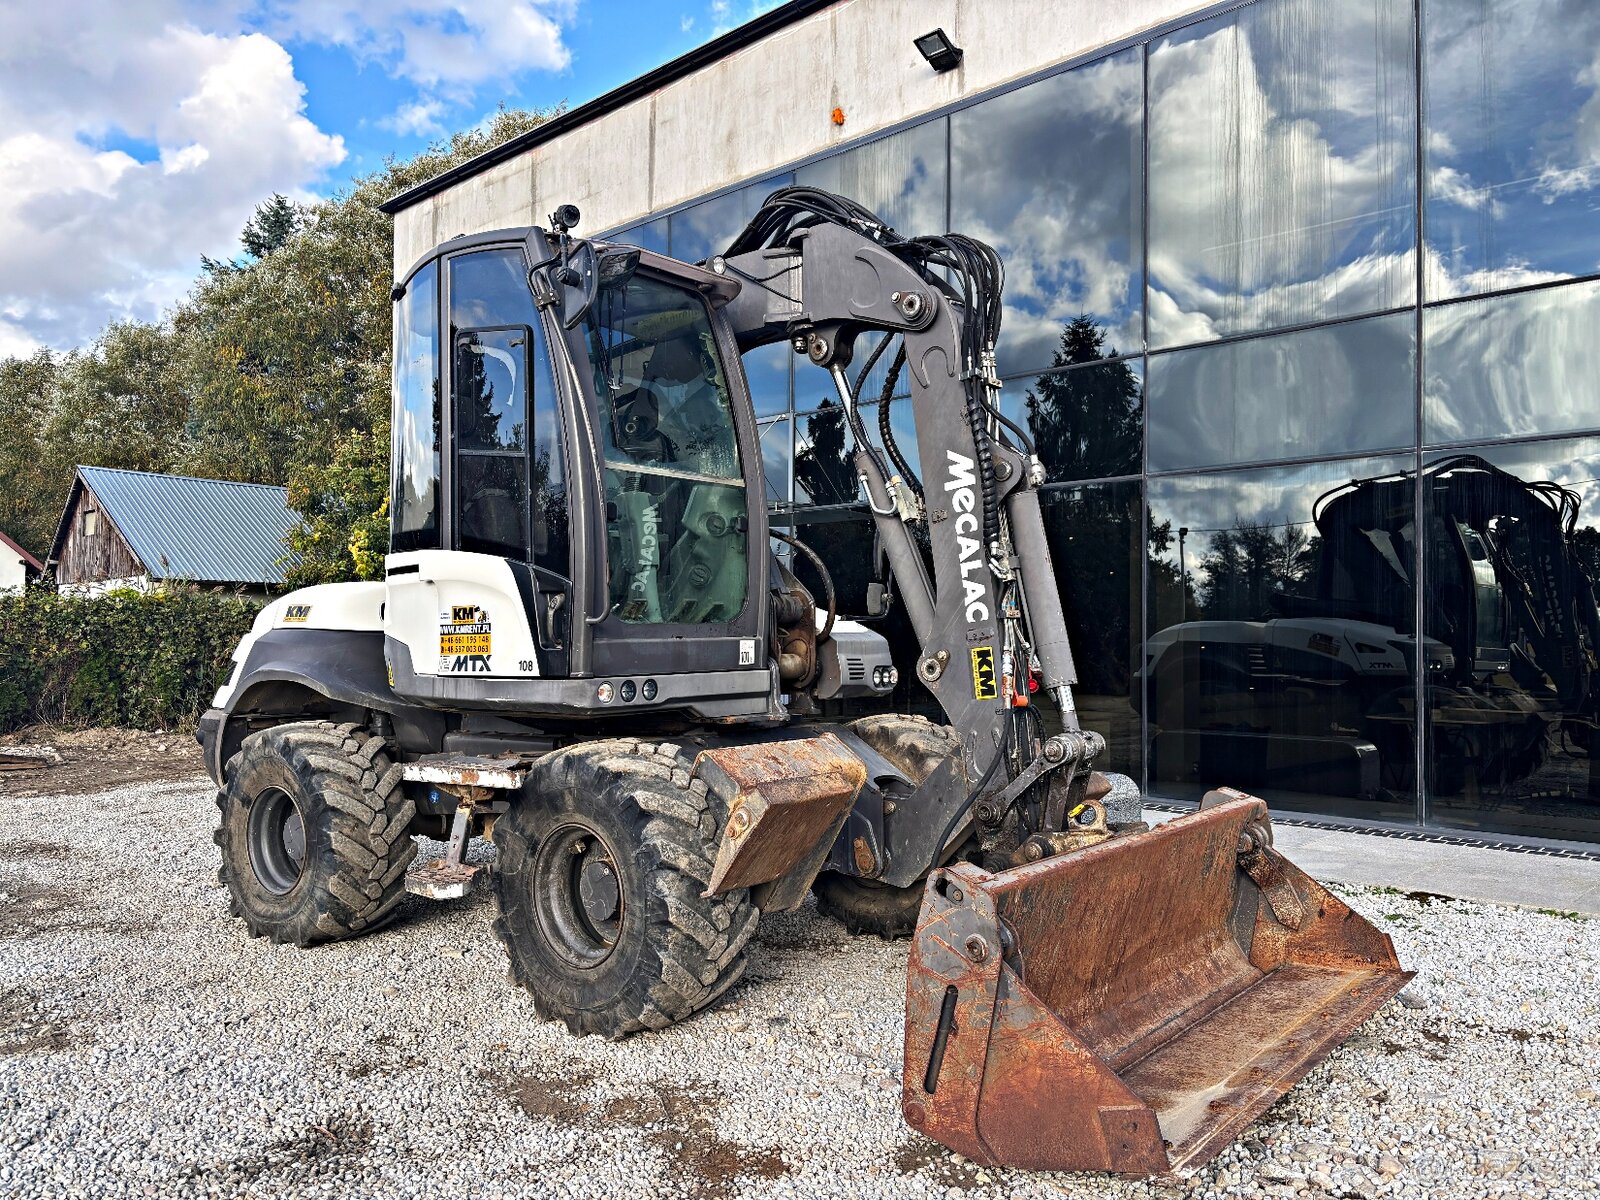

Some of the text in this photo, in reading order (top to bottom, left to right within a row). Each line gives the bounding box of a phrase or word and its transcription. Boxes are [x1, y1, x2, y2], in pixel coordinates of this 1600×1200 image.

[286, 605, 310, 617] KM
[453, 607, 474, 620] KM
[451, 654, 492, 672] MTX
[518, 660, 533, 672] 108
[976, 649, 996, 697] KM
